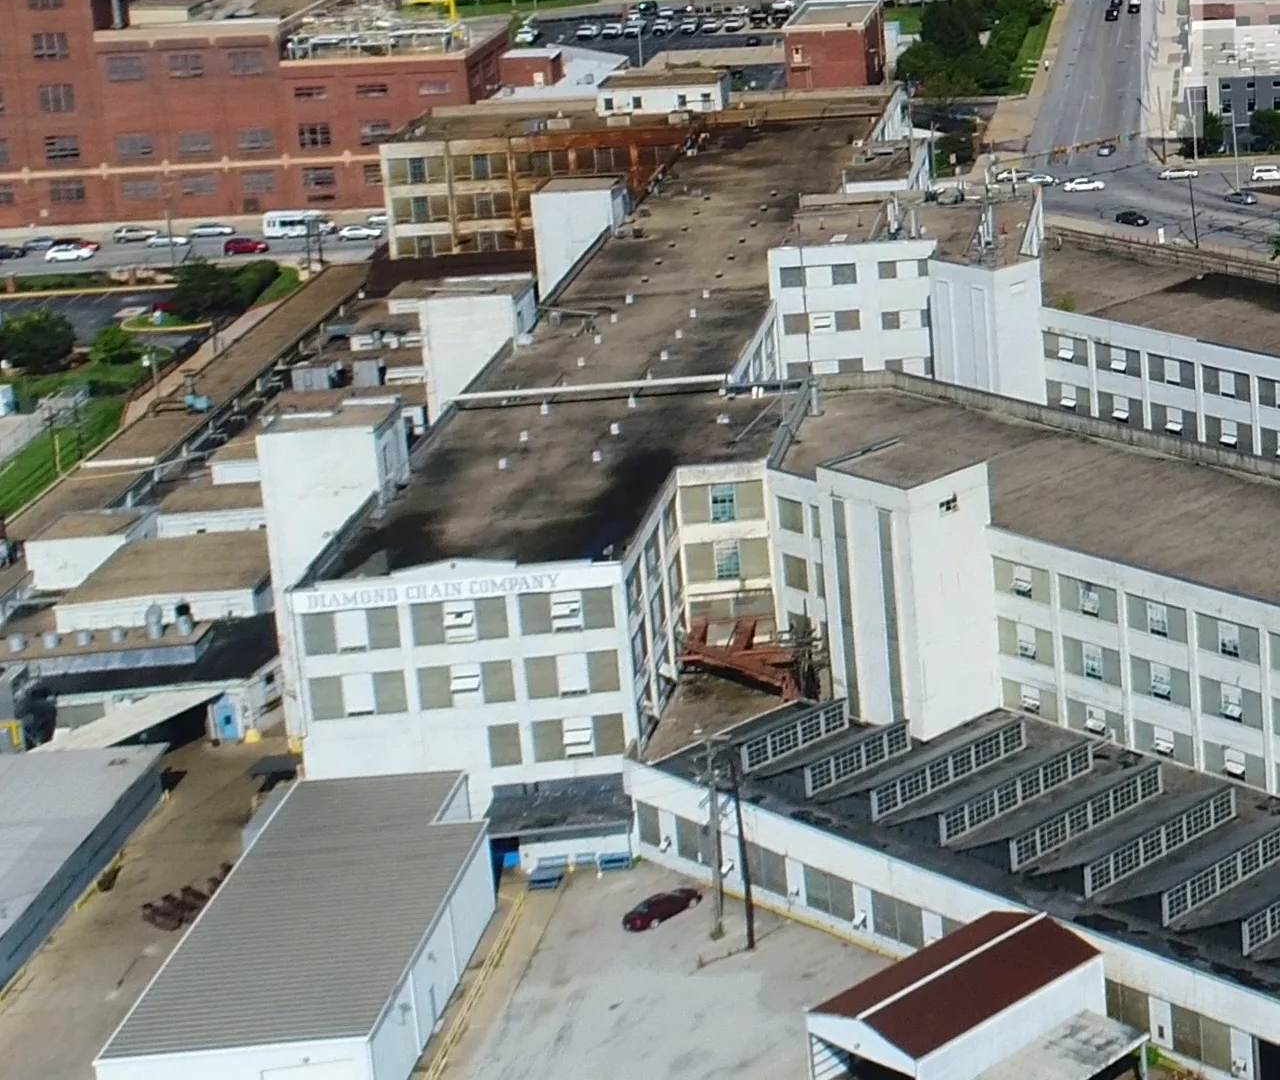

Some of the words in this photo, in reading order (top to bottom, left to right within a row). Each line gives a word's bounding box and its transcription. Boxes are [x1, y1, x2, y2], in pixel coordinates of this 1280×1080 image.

[307, 587, 399, 610] DIAMOND
[405, 582, 463, 600] CHAIN
[469, 572, 561, 593] COMPANY
